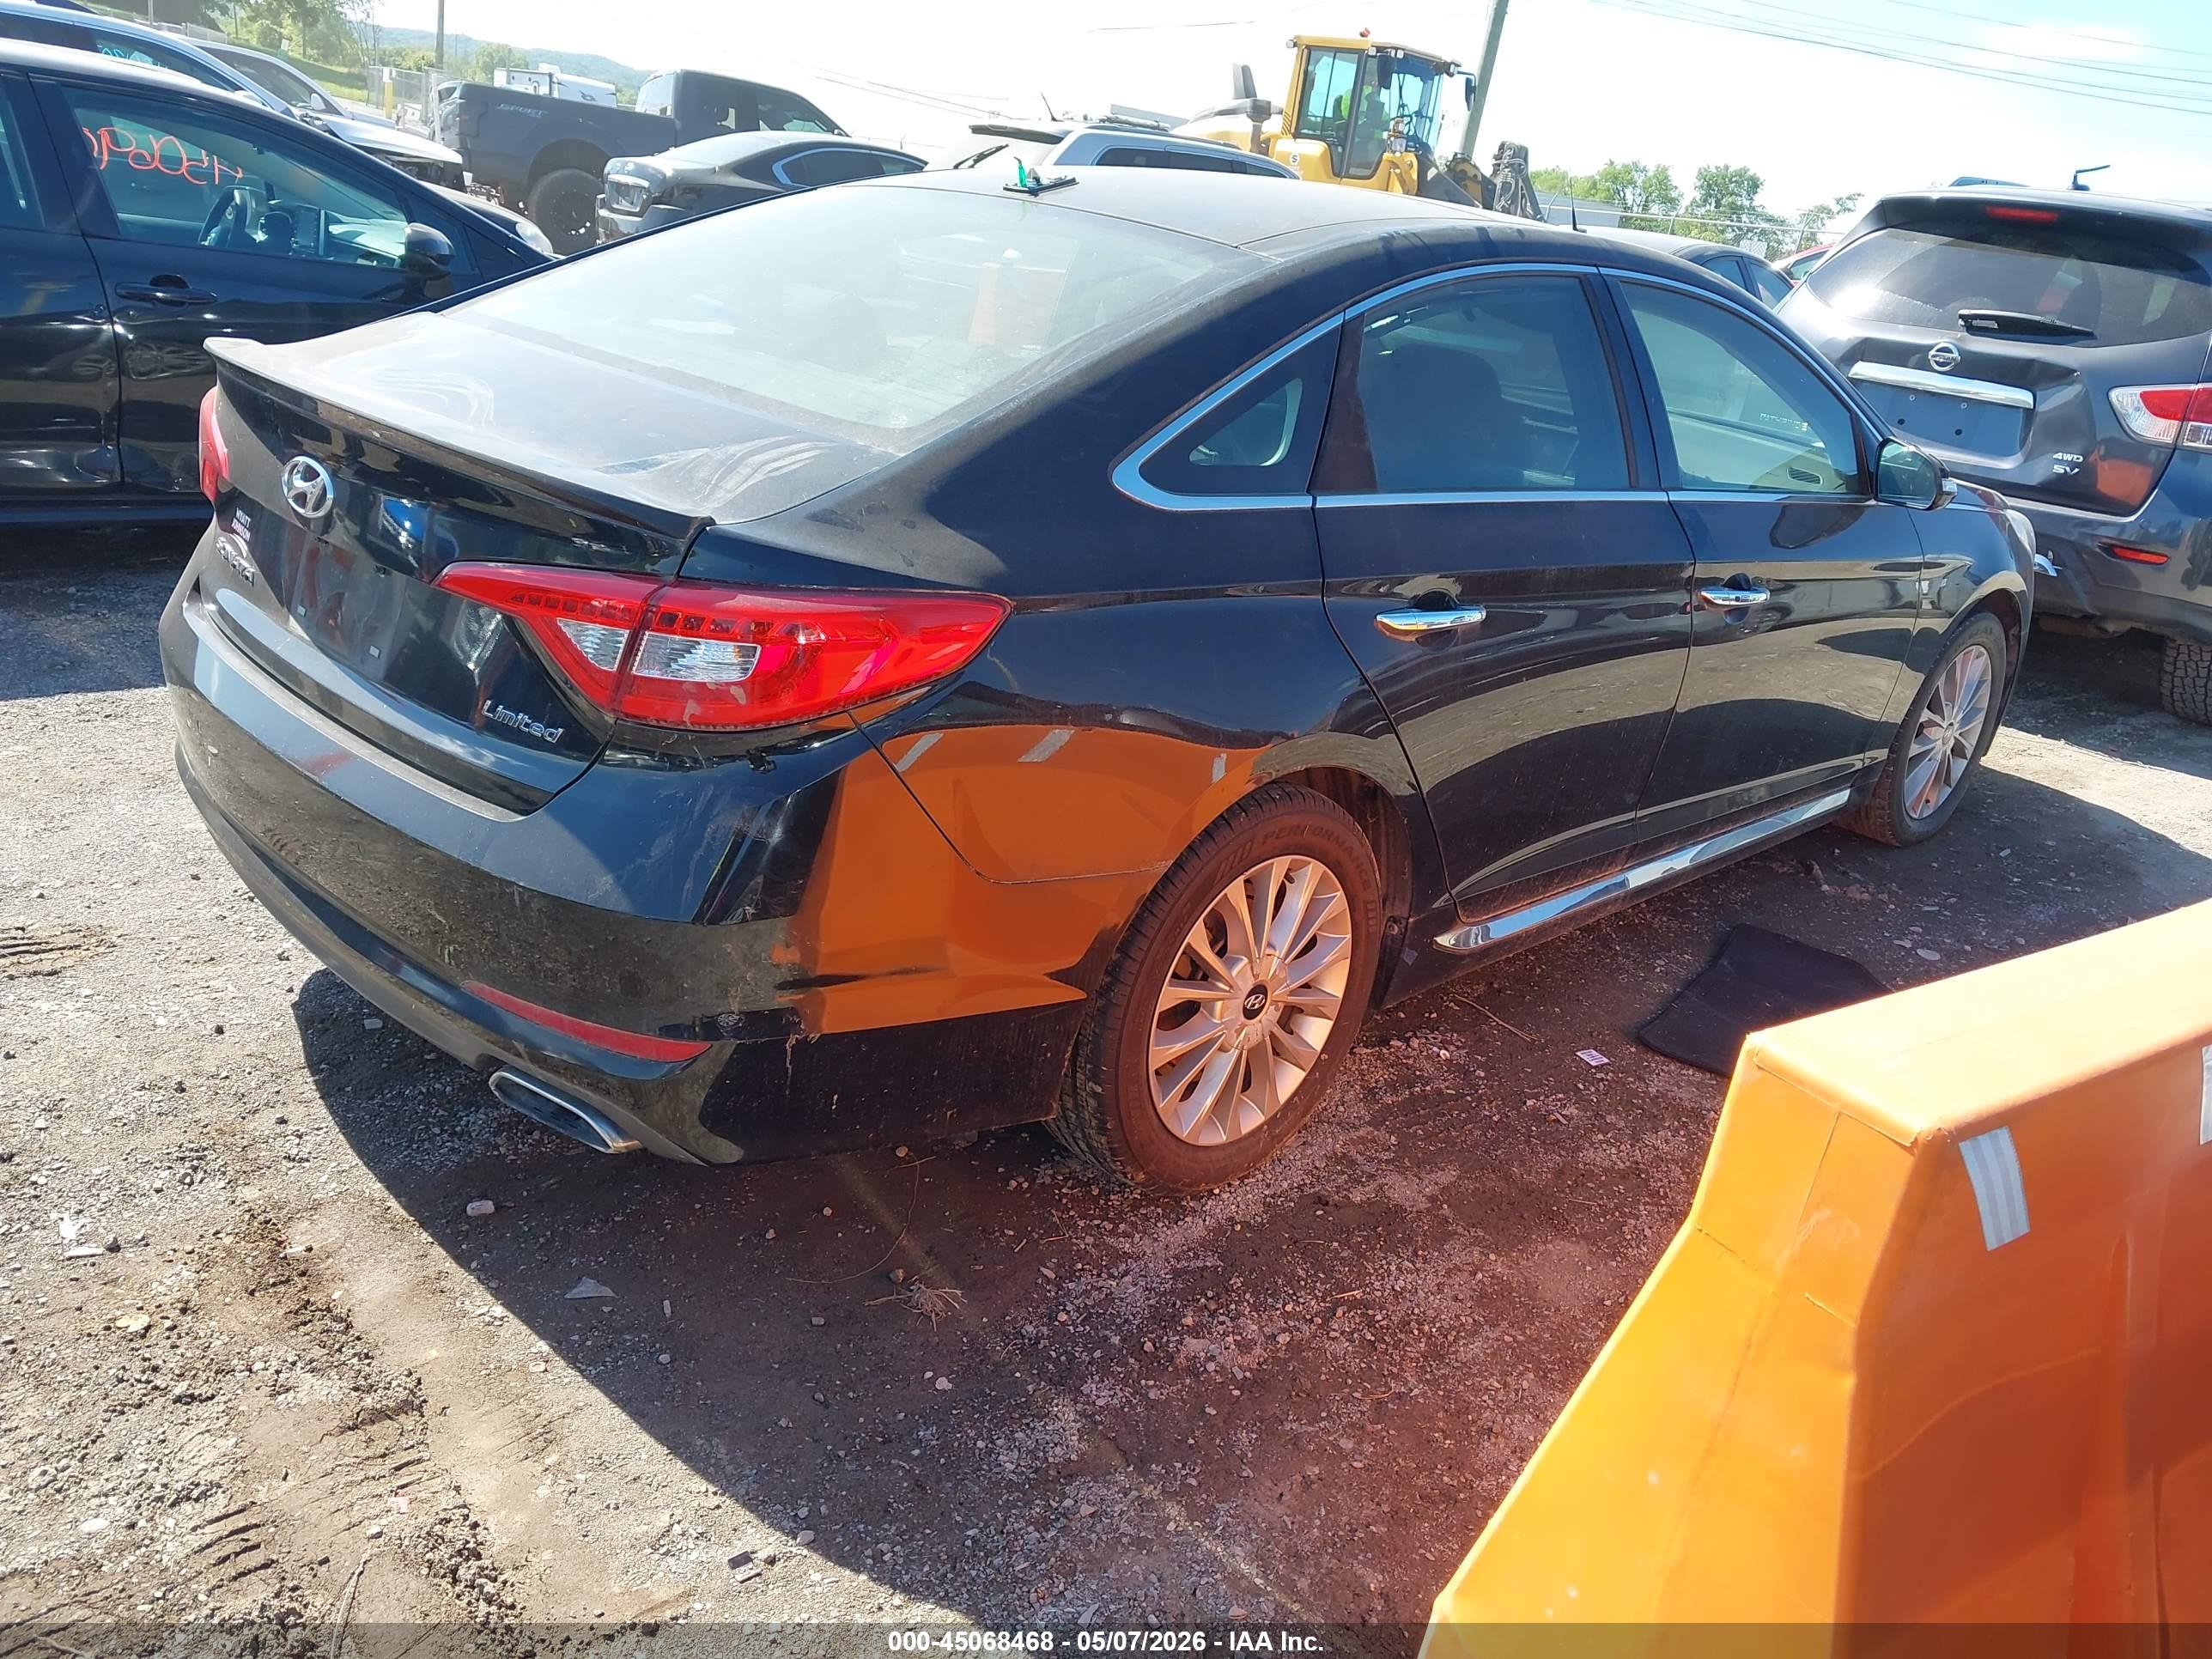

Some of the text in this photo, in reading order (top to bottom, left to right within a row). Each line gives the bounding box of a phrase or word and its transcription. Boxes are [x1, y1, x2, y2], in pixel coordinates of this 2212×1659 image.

[2052, 452, 2084, 462] 4WD
[2052, 464, 2081, 475] SV
[235, 507, 252, 528] WYATT
[231, 517, 251, 542] JOHNSON
[481, 700, 565, 744] Limited
